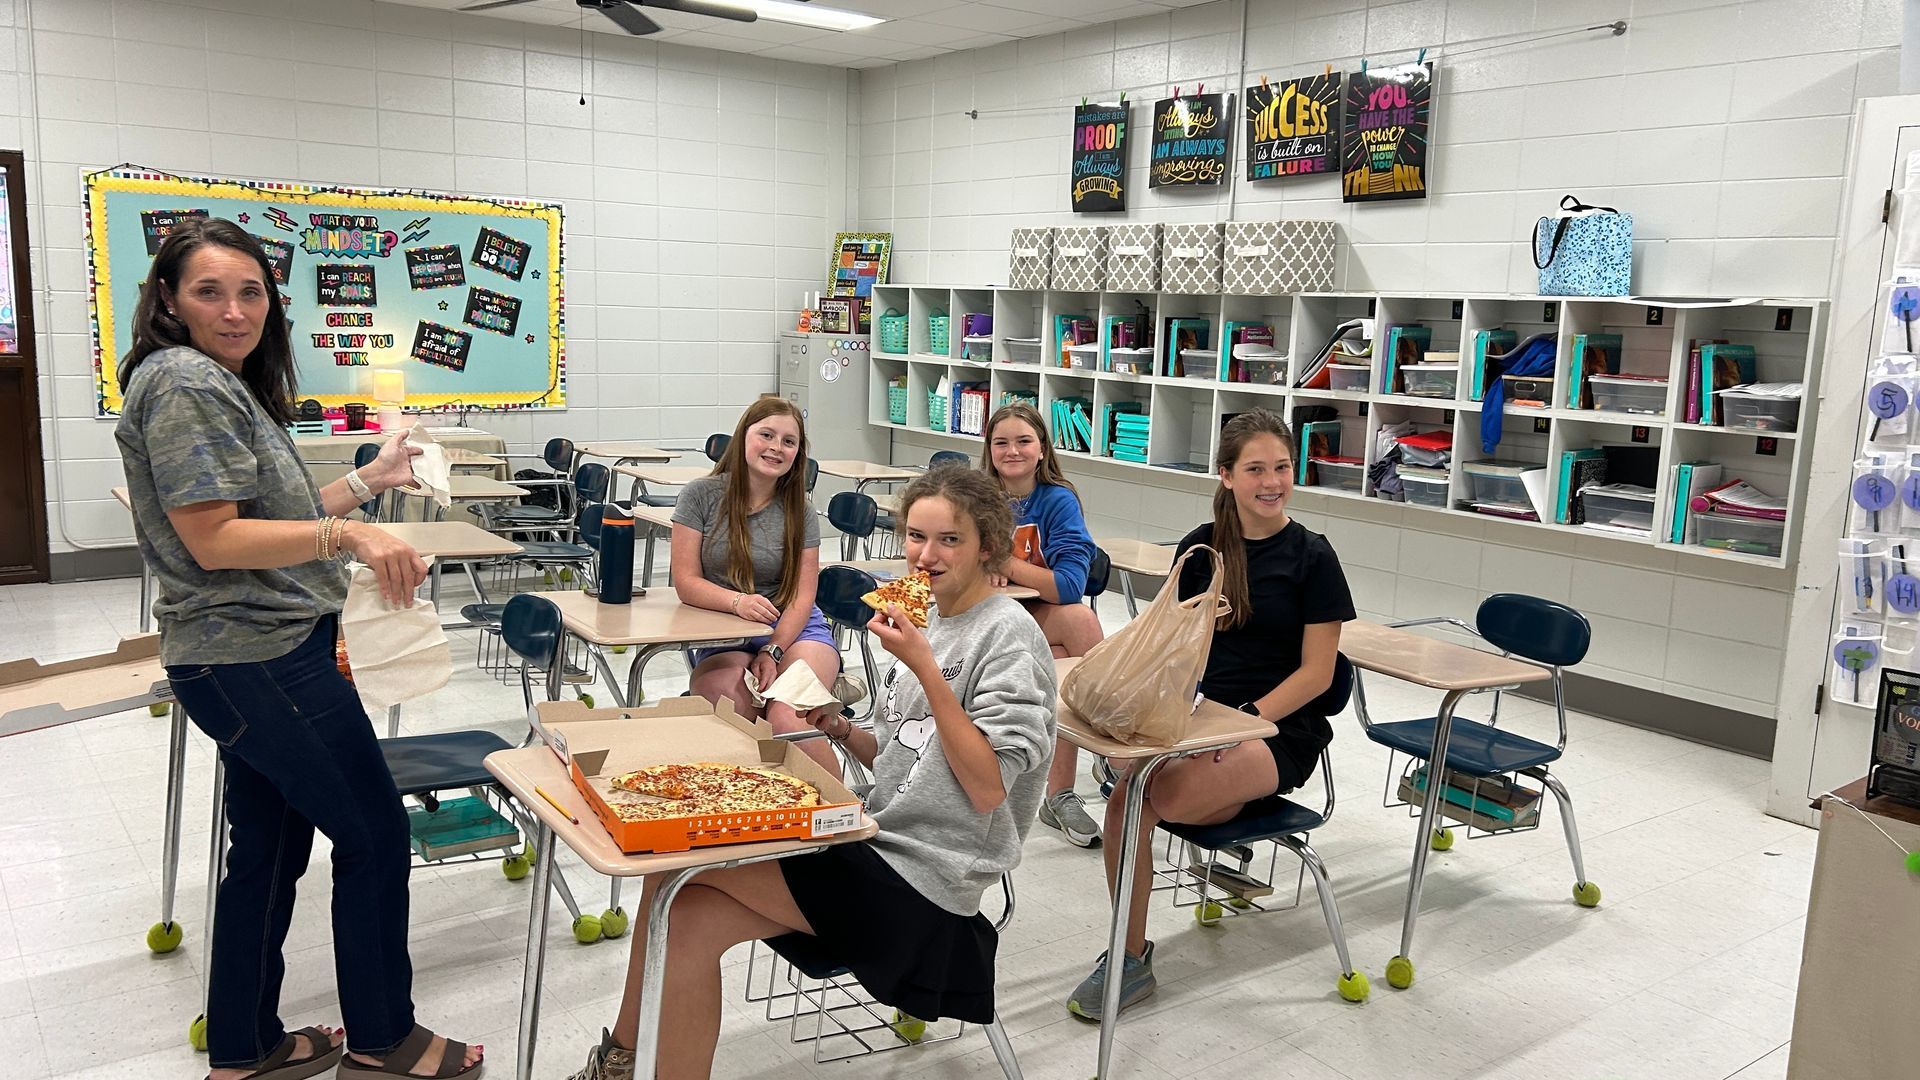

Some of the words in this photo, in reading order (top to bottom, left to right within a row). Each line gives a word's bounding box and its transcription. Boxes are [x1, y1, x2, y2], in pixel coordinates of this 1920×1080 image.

[1368, 84, 1407, 111] YOU
[1077, 112, 1111, 123] mistakes
[1111, 110, 1126, 121] are
[1254, 82, 1328, 143] SUCCESS
[1358, 110, 1389, 129] HAVE
[1392, 107, 1415, 126] THE
[1075, 122, 1125, 152] PROOF
[1361, 126, 1406, 143] power
[1155, 142, 1170, 159] AM
[1172, 139, 1226, 156] ALWAYS
[1257, 145, 1269, 161] is
[1270, 137, 1303, 159] built
[1304, 143, 1324, 155] on
[1376, 142, 1397, 152] CHANGE
[1372, 151, 1394, 161] HOW
[1074, 154, 1123, 177] Always
[1151, 156, 1225, 185] improving
[1254, 156, 1326, 178] FAILURE
[1373, 160, 1393, 170] YOU
[1079, 180, 1116, 193] GROWING
[159, 217, 174, 225] can
[311, 214, 341, 226] WHAT
[342, 215, 351, 227] IS
[354, 216, 378, 228] YOUR
[147, 226, 171, 236] MORE
[304, 228, 399, 257] MINDSET?
[490, 236, 522, 257] BELIEVE
[480, 250, 498, 266] DO
[326, 273, 340, 281] can
[342, 271, 371, 283] REACH
[321, 287, 337, 299] my
[485, 304, 502, 314] with
[1545, 308, 1552, 318] 3
[1650, 309, 1658, 321] 2
[327, 313, 373, 327] CHANGE
[312, 334, 335, 348] THE
[338, 334, 366, 348] WAY
[369, 334, 394, 348] YOU
[430, 332, 442, 341] am
[421, 339, 448, 354] afraid
[449, 347, 461, 357] of
[334, 352, 369, 366] THINK
[1634, 427, 1646, 438] 13
[1761, 439, 1773, 450] 12
[688, 820, 694, 828] 1
[697, 820, 703, 828] 2
[706, 819, 712, 827] 3
[716, 818, 722, 826] 4
[726, 817, 732, 825] 5
[736, 816, 742, 824] 6
[775, 813, 785, 821] 10
[789, 812, 796, 820] 11
[800, 811, 809, 819] 12
